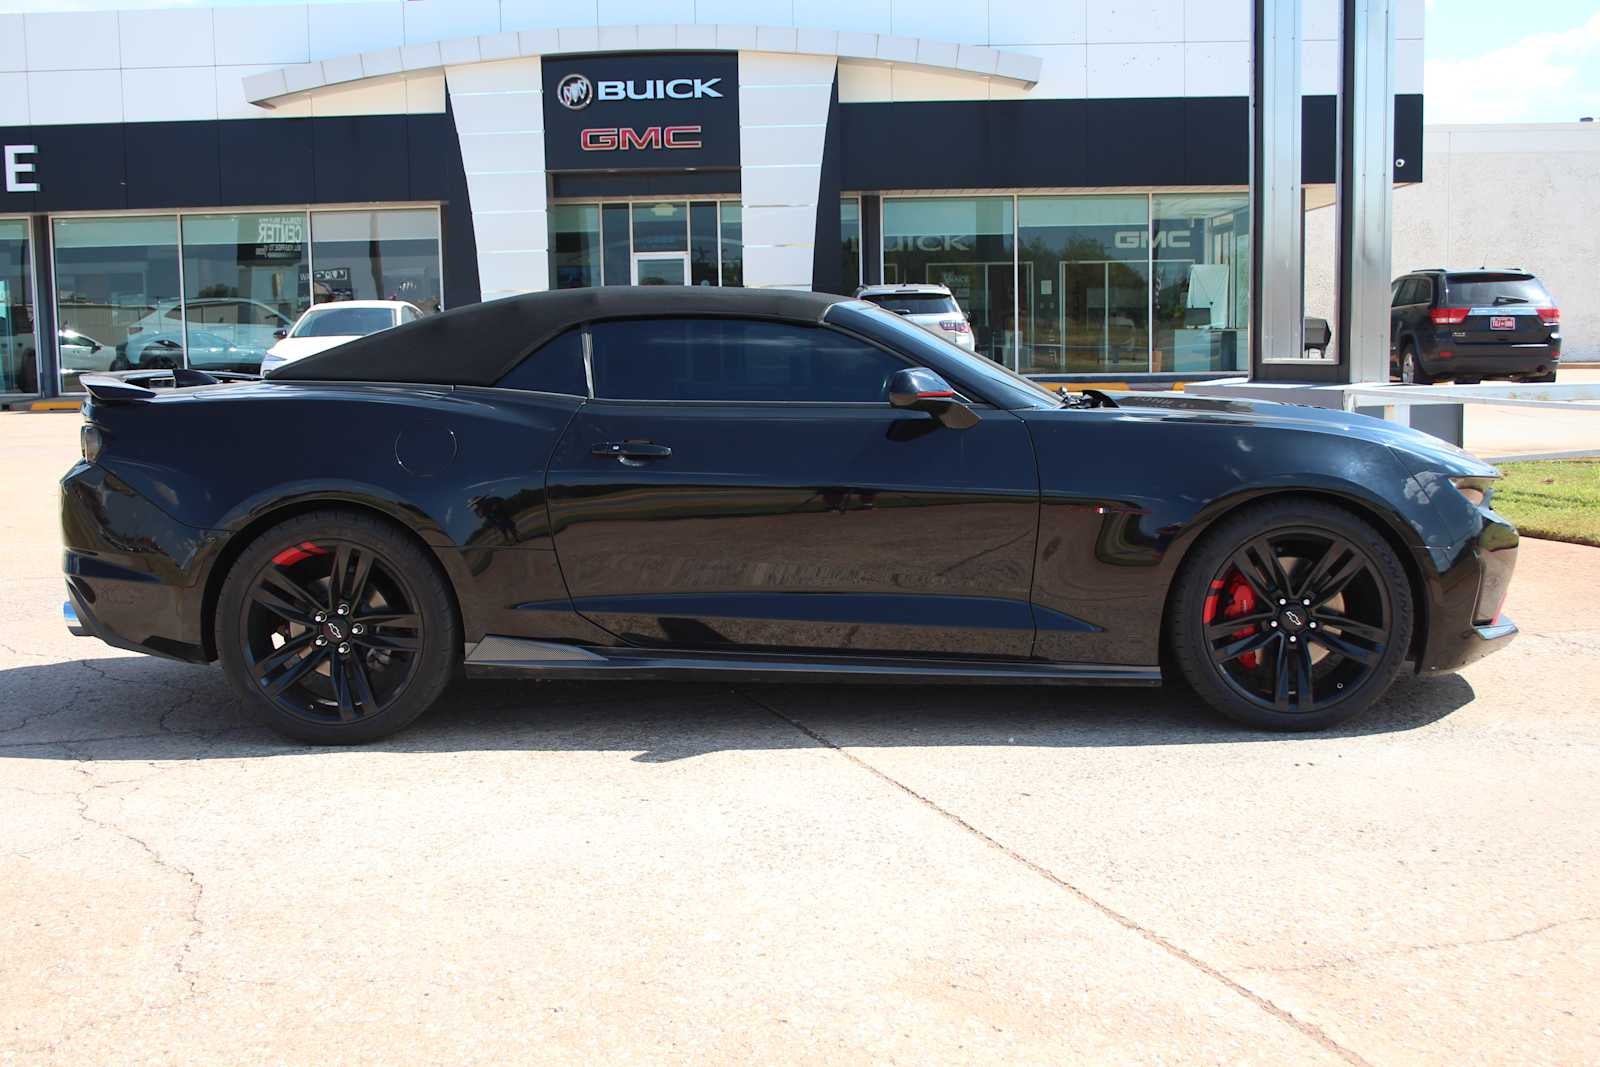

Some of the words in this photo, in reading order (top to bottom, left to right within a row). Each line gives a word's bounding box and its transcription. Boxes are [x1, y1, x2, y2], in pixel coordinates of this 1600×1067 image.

[597, 78, 724, 100] BUICK
[581, 125, 702, 151] GMC
[4, 145, 40, 192] E
[1115, 230, 1191, 249] GMC
